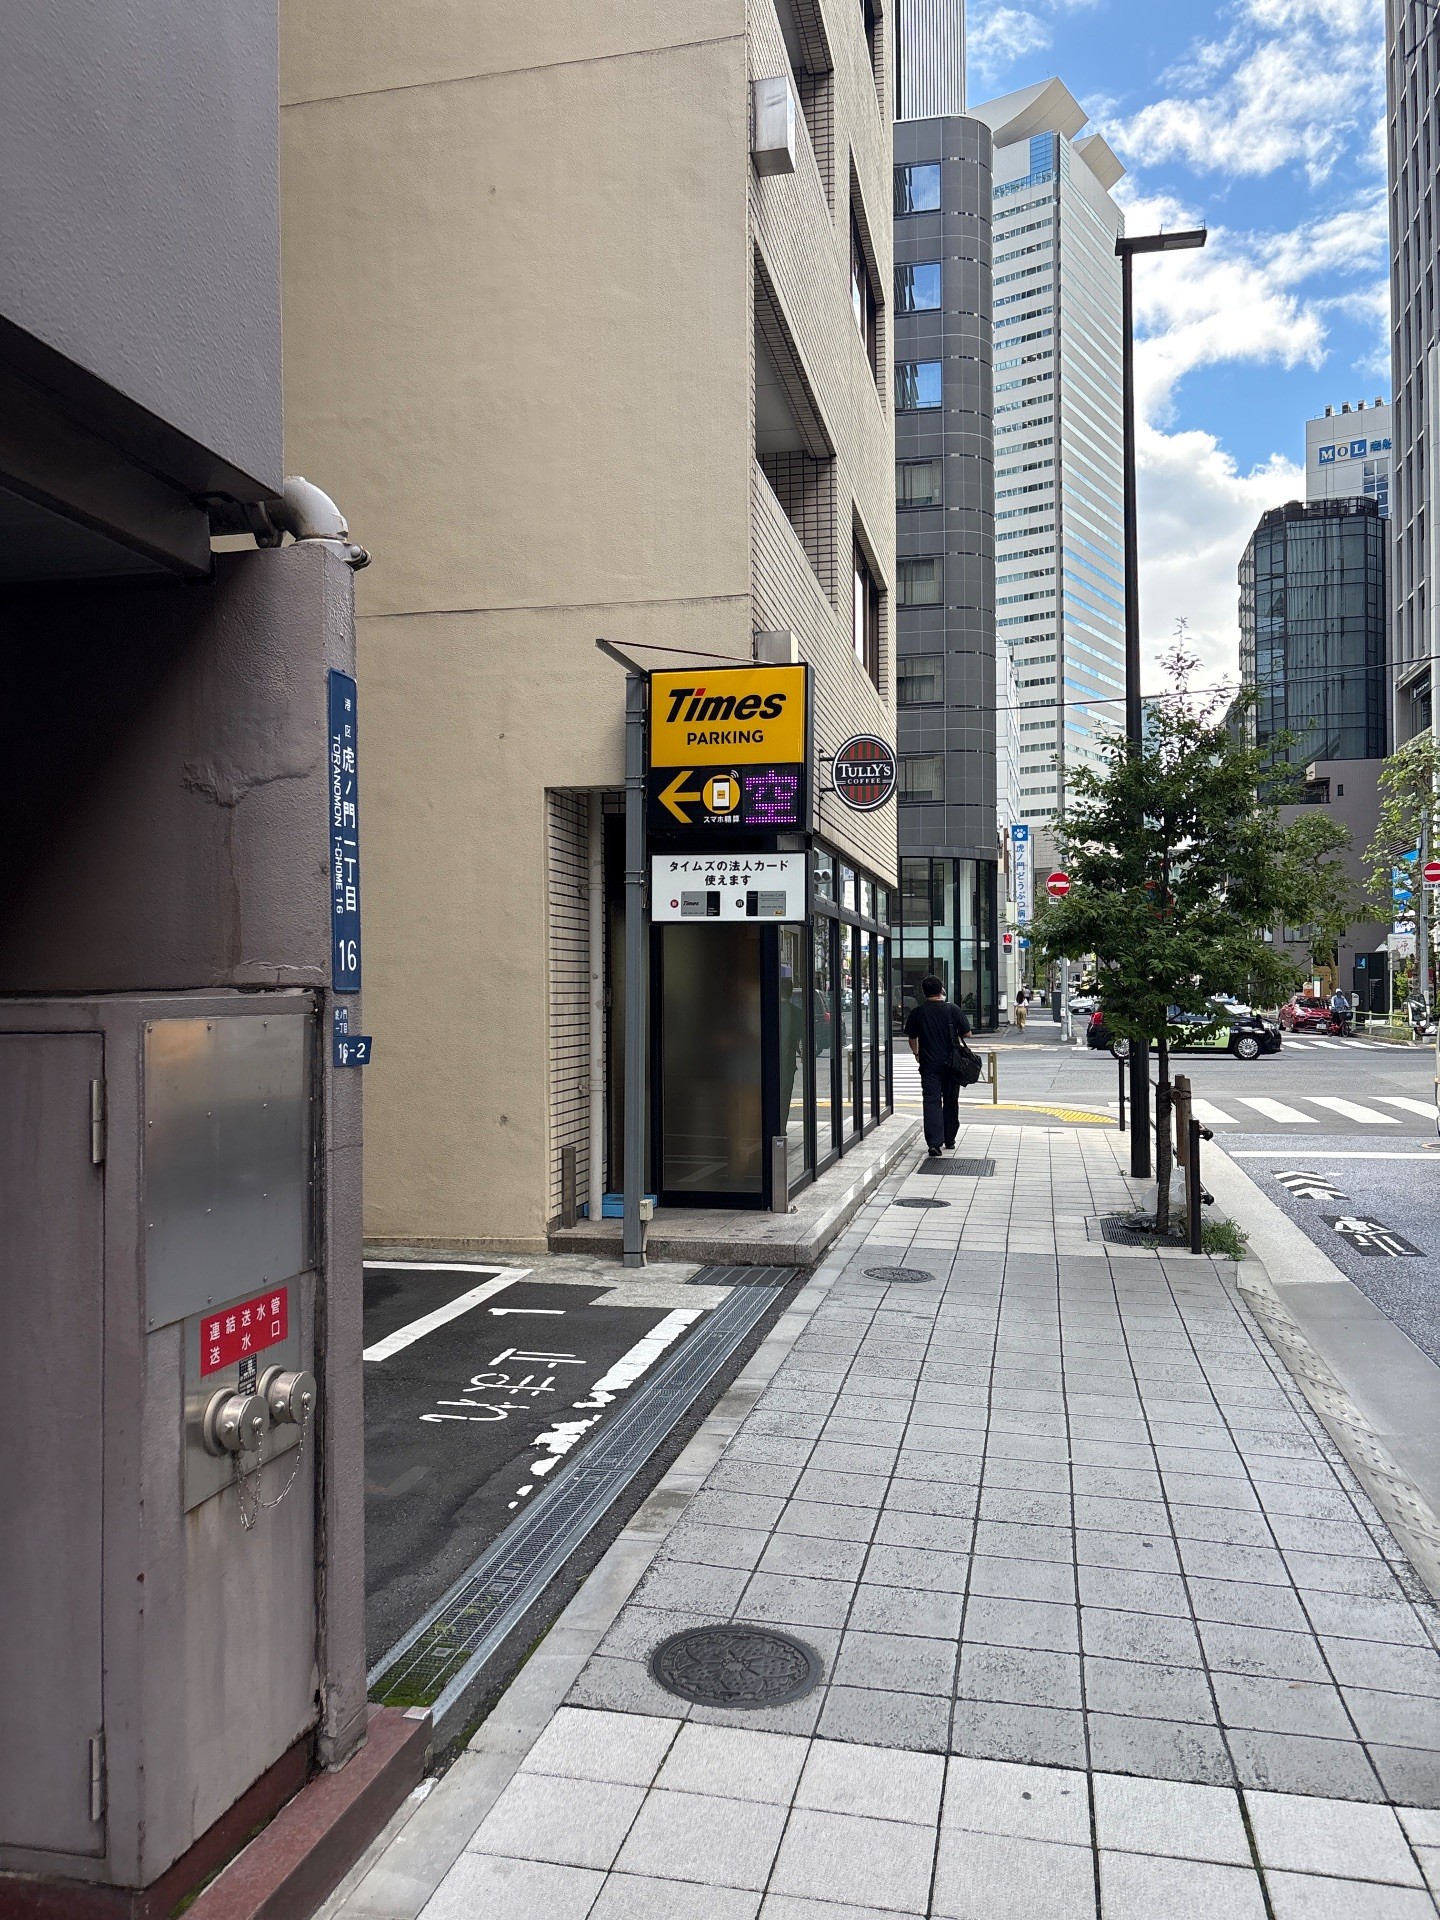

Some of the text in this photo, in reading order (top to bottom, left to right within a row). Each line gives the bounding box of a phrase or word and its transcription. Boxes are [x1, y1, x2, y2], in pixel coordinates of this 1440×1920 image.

[1320, 443, 1365, 462] MOL
[665, 687, 787, 723] Times
[687, 729, 764, 746] PARKING
[838, 763, 891, 777] TULLY'S
[745, 769, 798, 824] 空
[332, 733, 344, 914] TORANOMON 1-CHOME 16
[342, 745, 357, 912] 虎ノ門一丁目
[703, 814, 740, 824] スマホ精算
[669, 859, 789, 873] タイムズの法人カード
[704, 874, 752, 887] 使えます
[338, 939, 357, 971] 16
[338, 1042, 366, 1061] 16-2
[209, 1296, 281, 1342] 連結送水管
